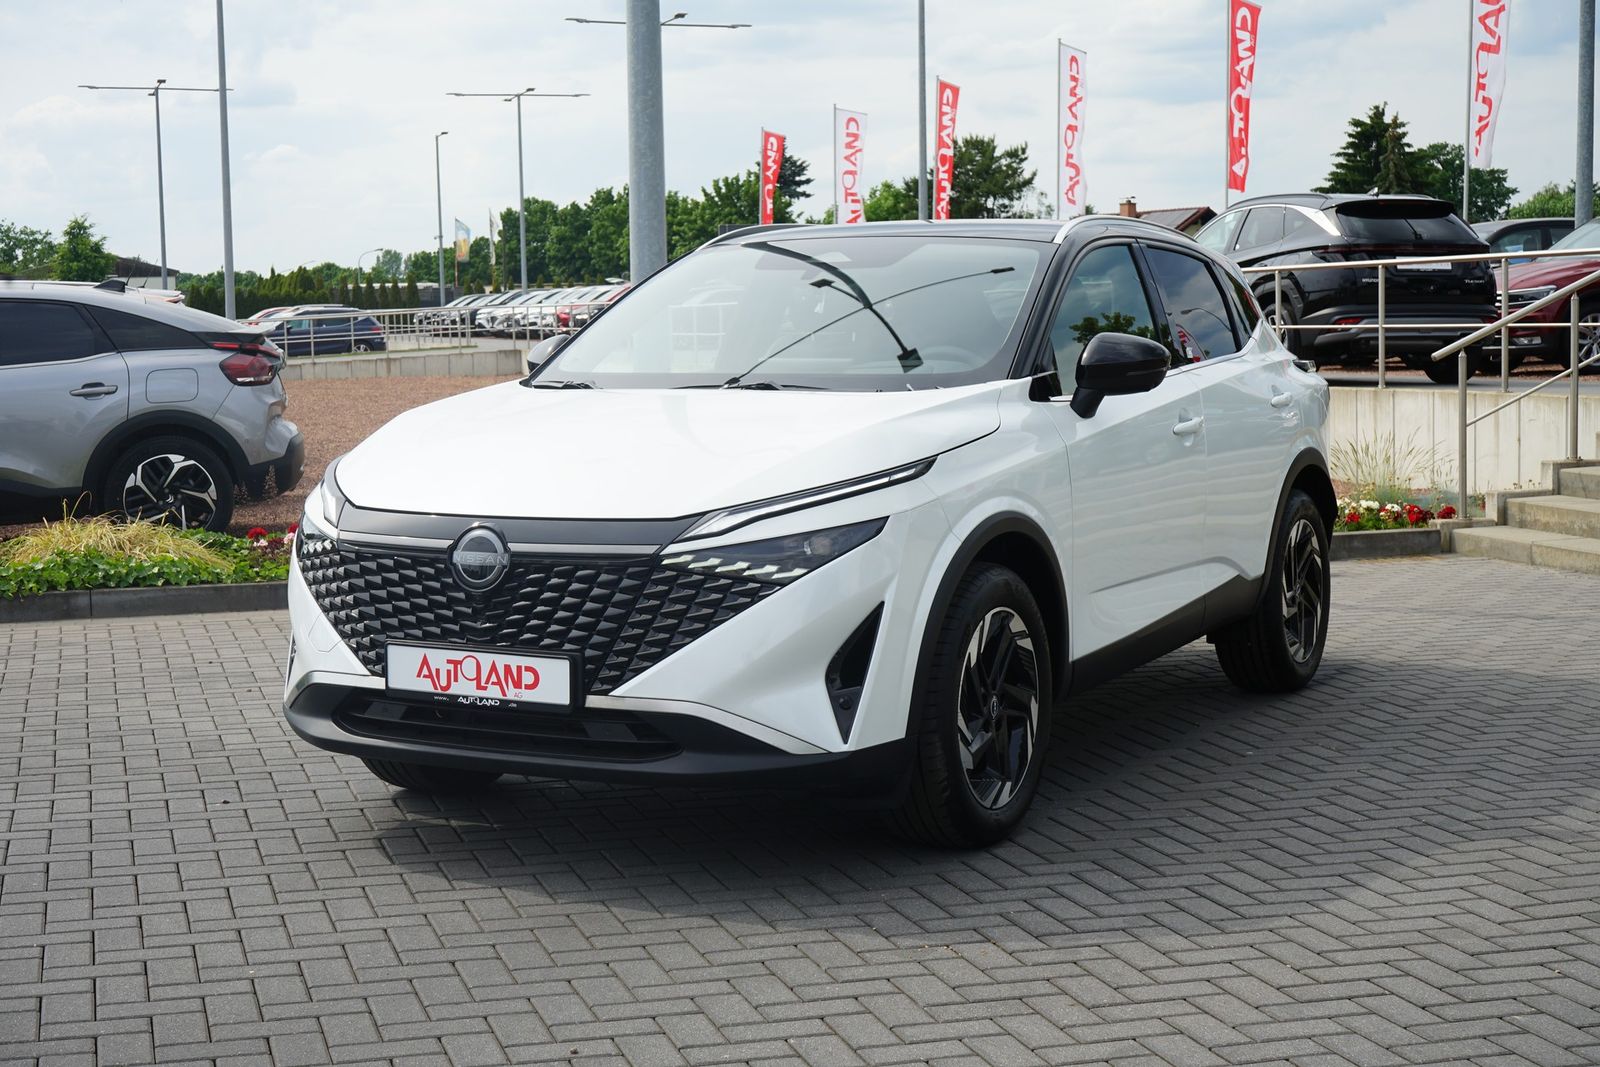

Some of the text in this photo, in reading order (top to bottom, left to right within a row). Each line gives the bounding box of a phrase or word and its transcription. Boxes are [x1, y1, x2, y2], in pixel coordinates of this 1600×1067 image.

[455, 553, 507, 565] NISSAN
[416, 652, 540, 697] AUTOLAND
[513, 691, 523, 699] AG
[457, 696, 500, 707] AUTOLAND
